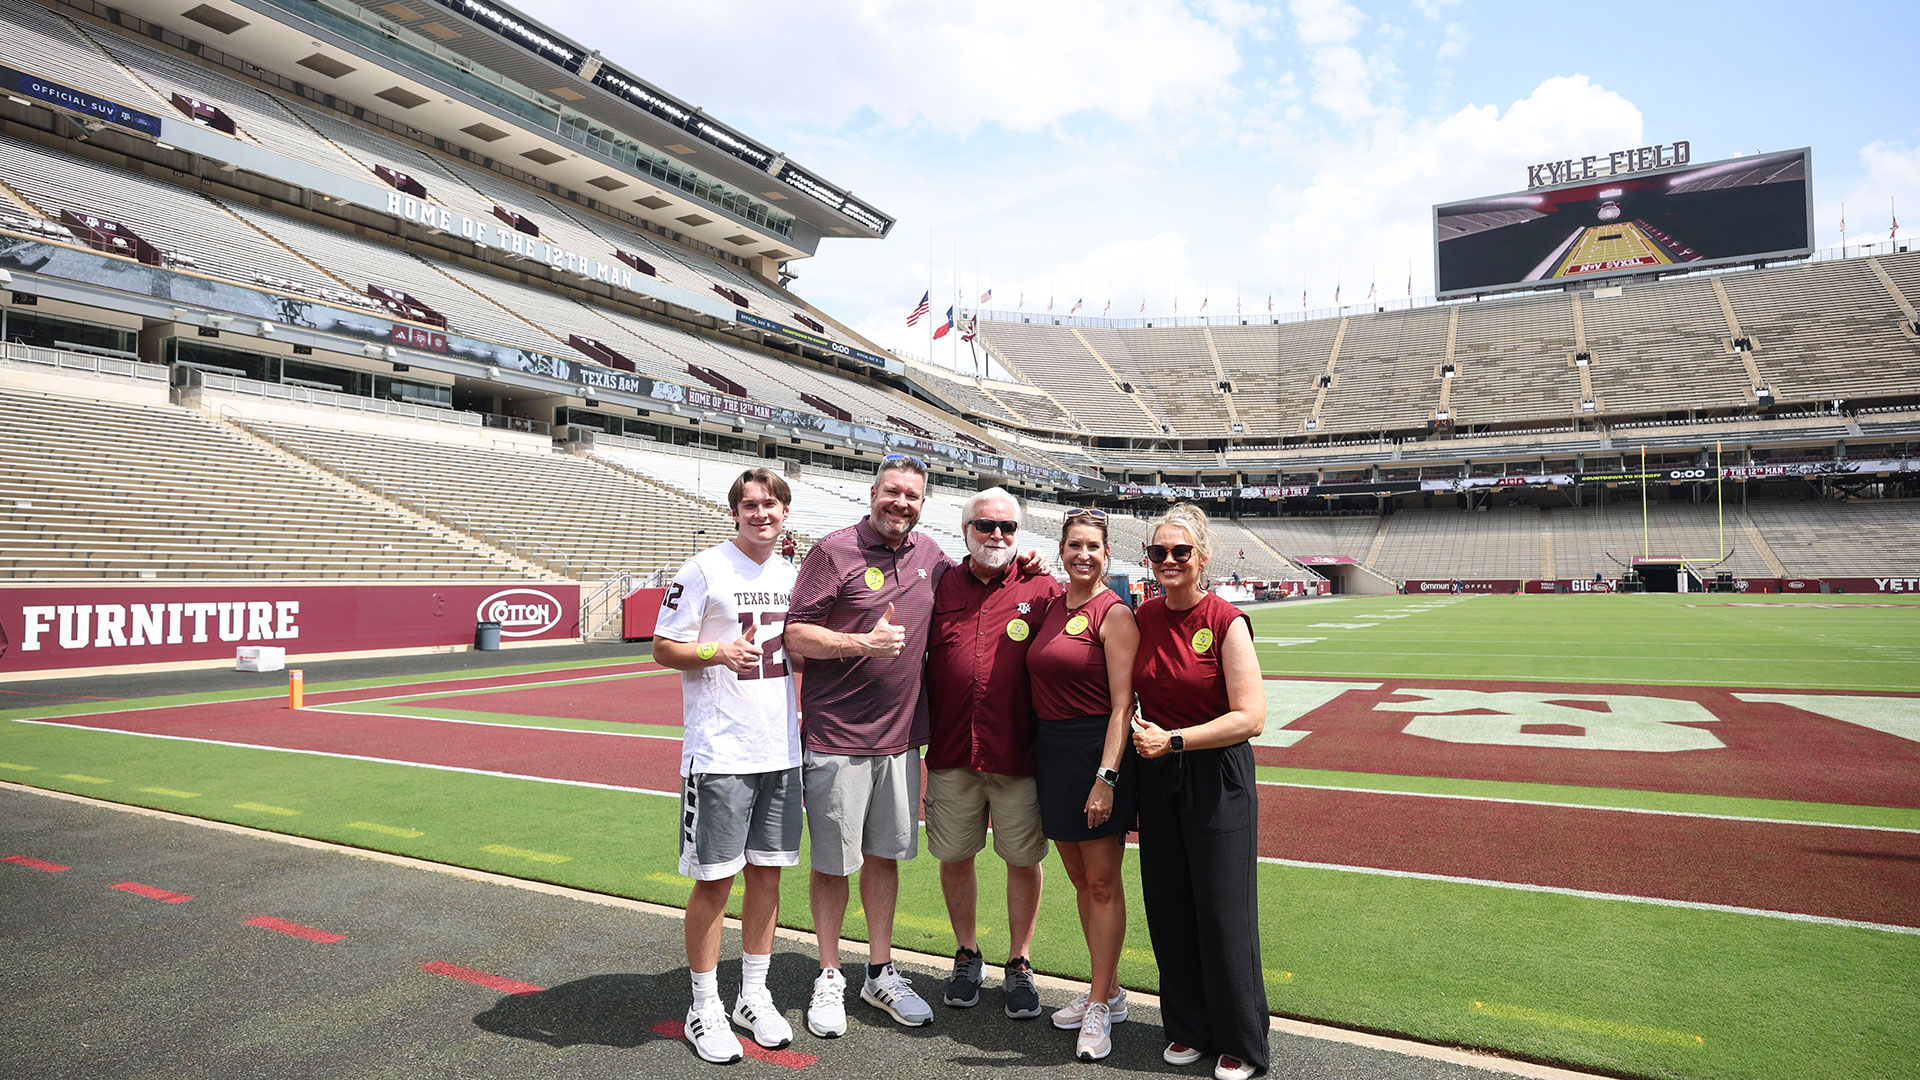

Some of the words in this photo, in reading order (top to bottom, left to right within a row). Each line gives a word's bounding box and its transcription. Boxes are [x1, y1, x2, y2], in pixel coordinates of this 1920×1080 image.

[32, 83, 87, 107] OFFICIAL
[91, 102, 115, 116] SUV
[1527, 155, 1598, 189] KYLE
[1608, 140, 1691, 176] FIELD
[386, 191, 451, 232] HOME
[462, 216, 487, 242] OF
[497, 230, 535, 258] THE
[544, 244, 588, 275] 12TH
[596, 261, 632, 289] MAN
[832, 342, 850, 355] 0:00
[580, 369, 617, 390] TEXAS
[618, 376, 639, 393] A&M
[689, 391, 711, 407] HOME
[712, 397, 722, 409] OF
[723, 398, 739, 412] THE
[740, 400, 754, 414] 12TH
[754, 405, 770, 418] MAN
[1670, 470, 1705, 479] 0:00
[1729, 468, 1747, 476] THE
[1765, 466, 1783, 475] MAN
[1199, 489, 1220, 498] TEXAS
[663, 582, 684, 611] 12
[734, 592, 770, 606] TEXAS
[1571, 580, 1593, 592] GIG
[21, 600, 300, 652] FURNITURE
[488, 599, 551, 626] COTTON
[737, 611, 789, 681] 12
